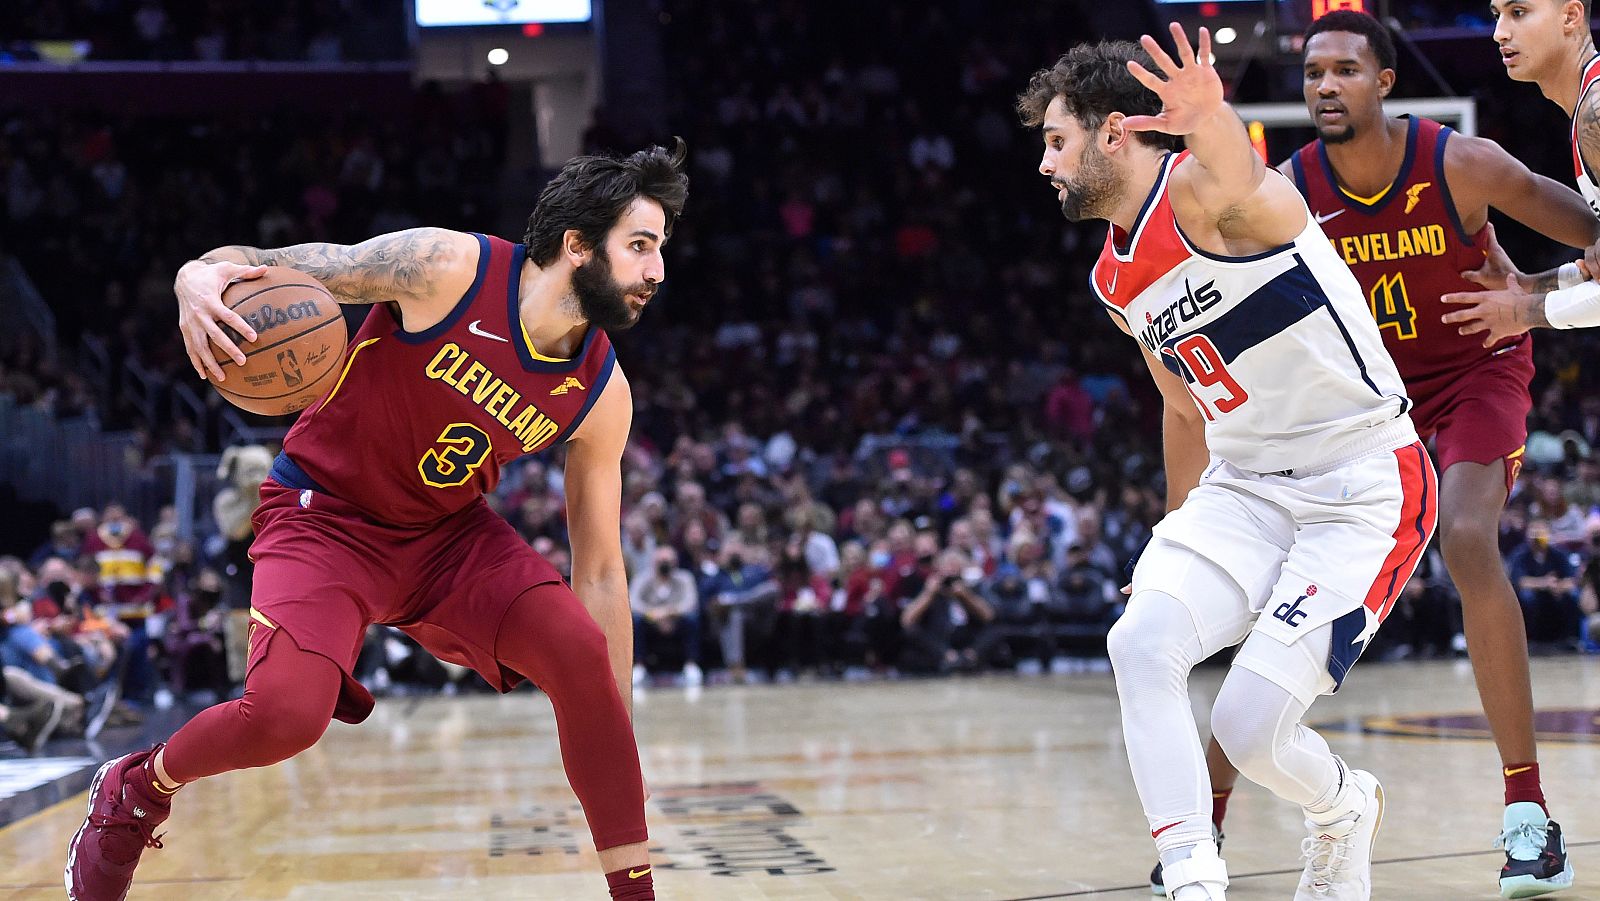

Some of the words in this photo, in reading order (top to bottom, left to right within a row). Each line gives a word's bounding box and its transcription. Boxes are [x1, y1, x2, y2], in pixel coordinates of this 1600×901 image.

[1329, 224, 1447, 265] EVELAND
[1138, 276, 1223, 354] wizards
[1370, 271, 1418, 341] 4
[425, 342, 559, 453] CLEVELAND
[417, 422, 493, 489] 3
